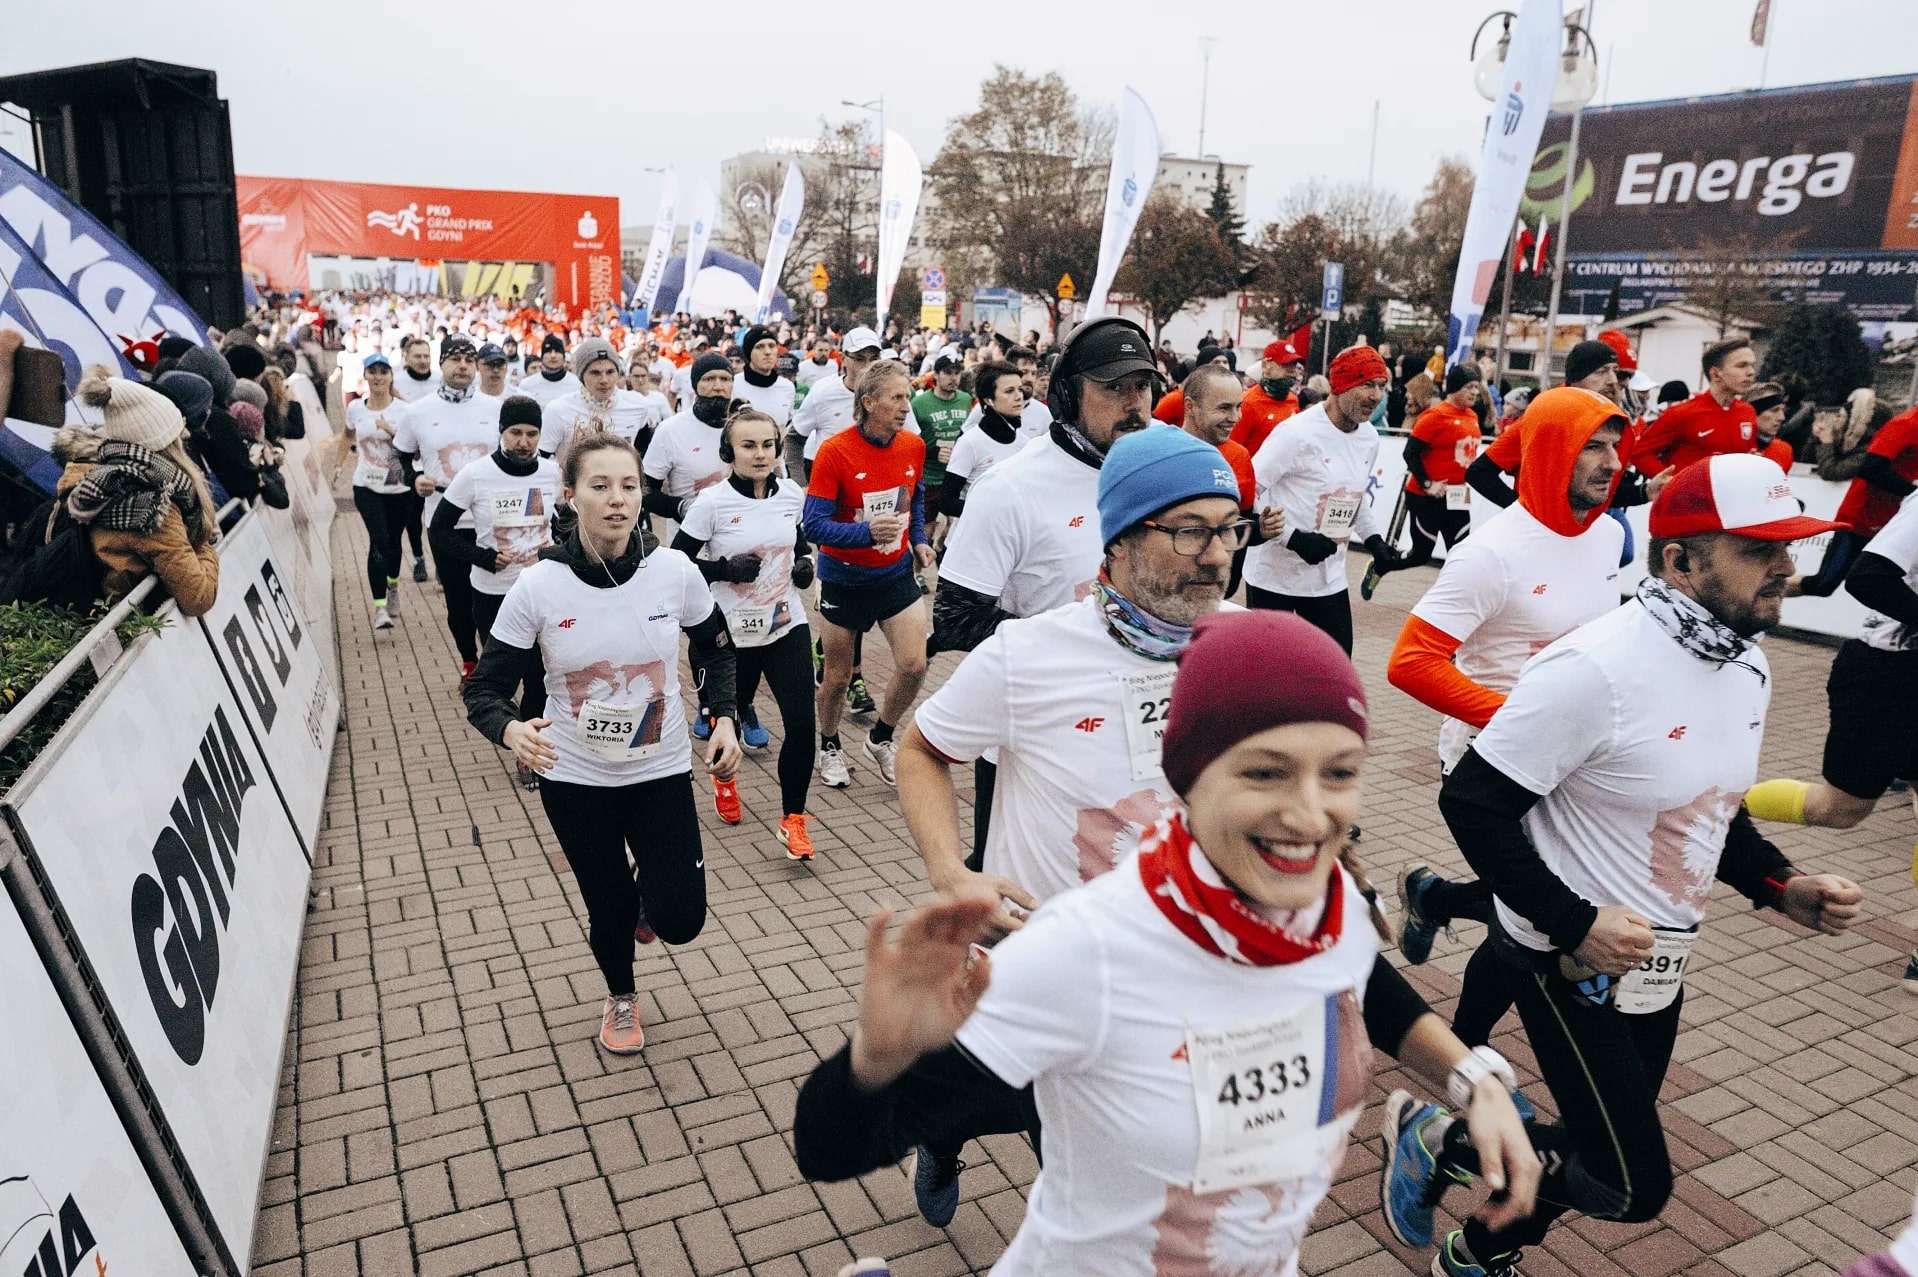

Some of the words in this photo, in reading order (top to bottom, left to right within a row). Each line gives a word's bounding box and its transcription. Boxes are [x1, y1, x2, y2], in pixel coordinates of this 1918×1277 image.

[1615, 151, 1855, 216] Energa
[426, 205, 451, 217] PKO
[427, 217, 466, 230] GRAND
[468, 219, 492, 230] PRIX
[427, 229, 462, 241] GDYNI
[1577, 262, 1637, 276] CENTRUM
[1326, 289, 1338, 308] P
[496, 499, 523, 509] 3247
[870, 500, 893, 512] 1475
[1068, 516, 1085, 528] 4F
[1532, 584, 1547, 595] 4F
[558, 618, 577, 629] 4F
[742, 618, 764, 629] 341
[586, 718, 633, 734] 3733
[1075, 717, 1105, 733] 4F
[586, 733, 625, 743] WIKTORIA
[1668, 725, 1687, 740] 4F
[131, 703, 256, 1067] GDYNIA
[1640, 956, 1684, 973] 391
[1218, 1054, 1311, 1106] 4333
[1243, 1108, 1287, 1132] ANNA
